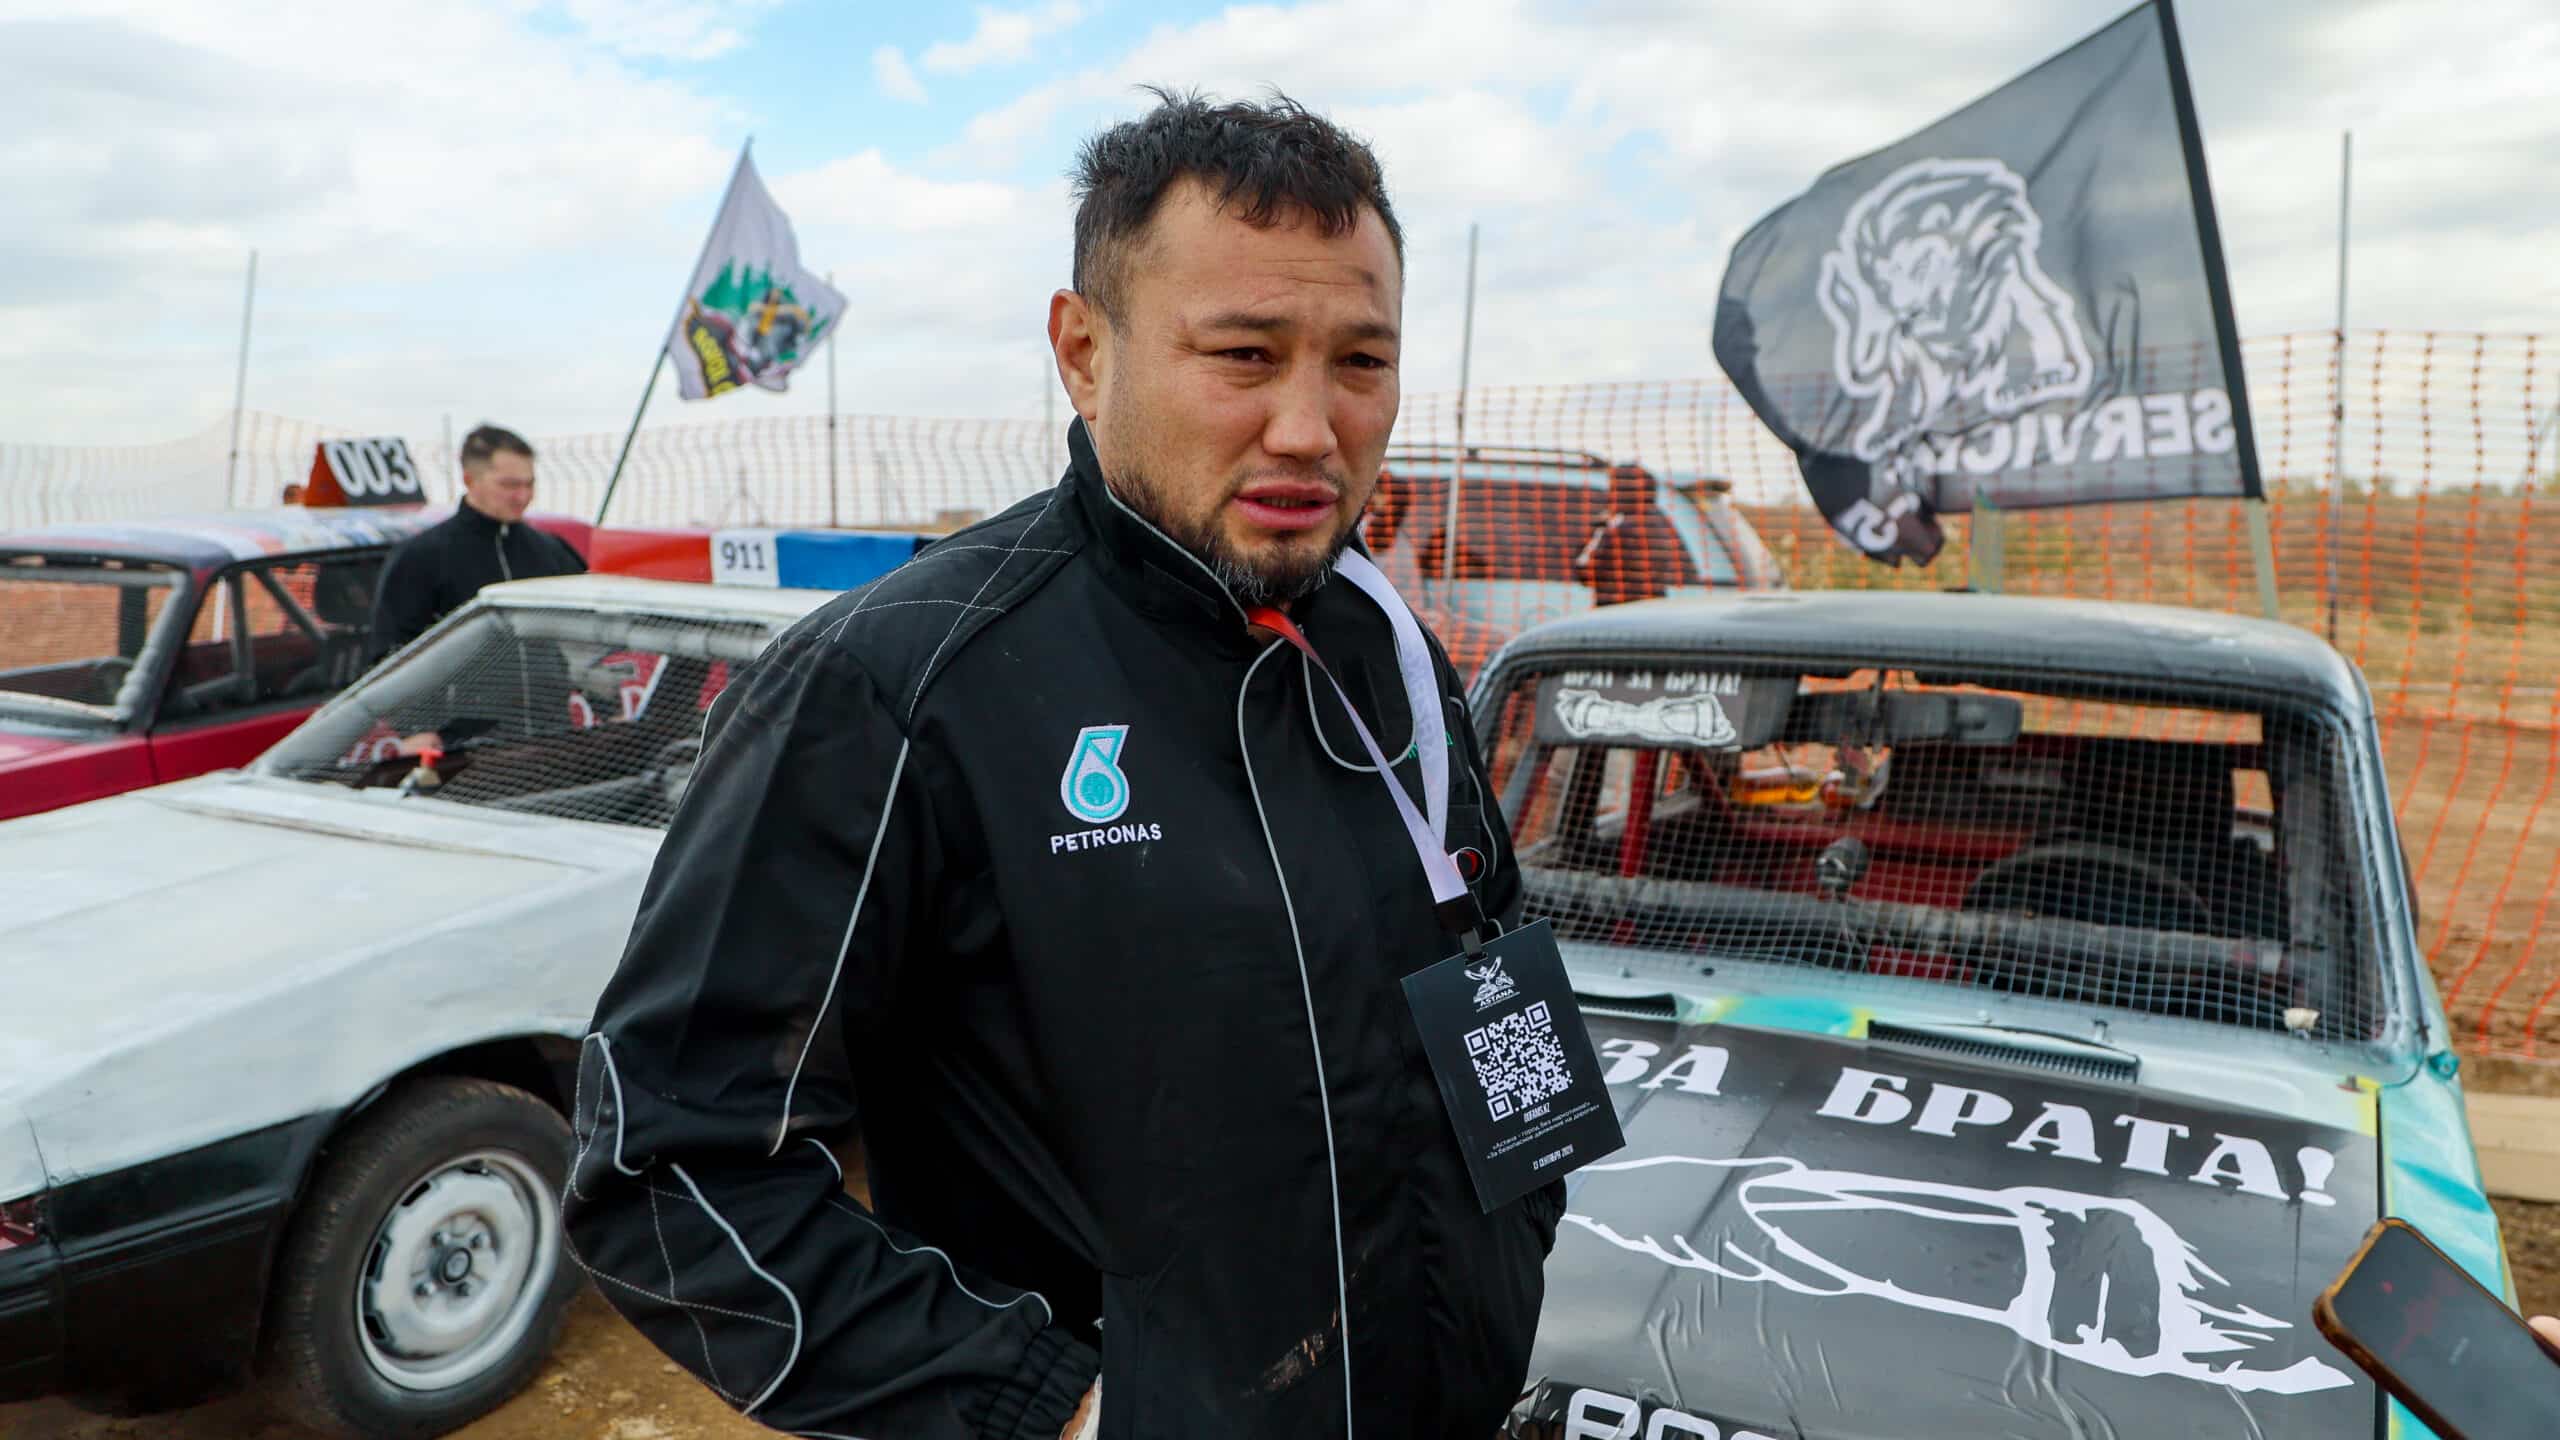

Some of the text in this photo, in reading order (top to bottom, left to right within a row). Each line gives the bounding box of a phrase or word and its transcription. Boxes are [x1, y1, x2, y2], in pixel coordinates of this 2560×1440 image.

[325, 436, 418, 496] 003
[721, 540, 766, 571] 911
[1050, 823, 1163, 855] PETRONAS
[1480, 988, 1515, 1007] ASTANA
[1601, 1038, 2337, 1208] ЗА БРАТА!
